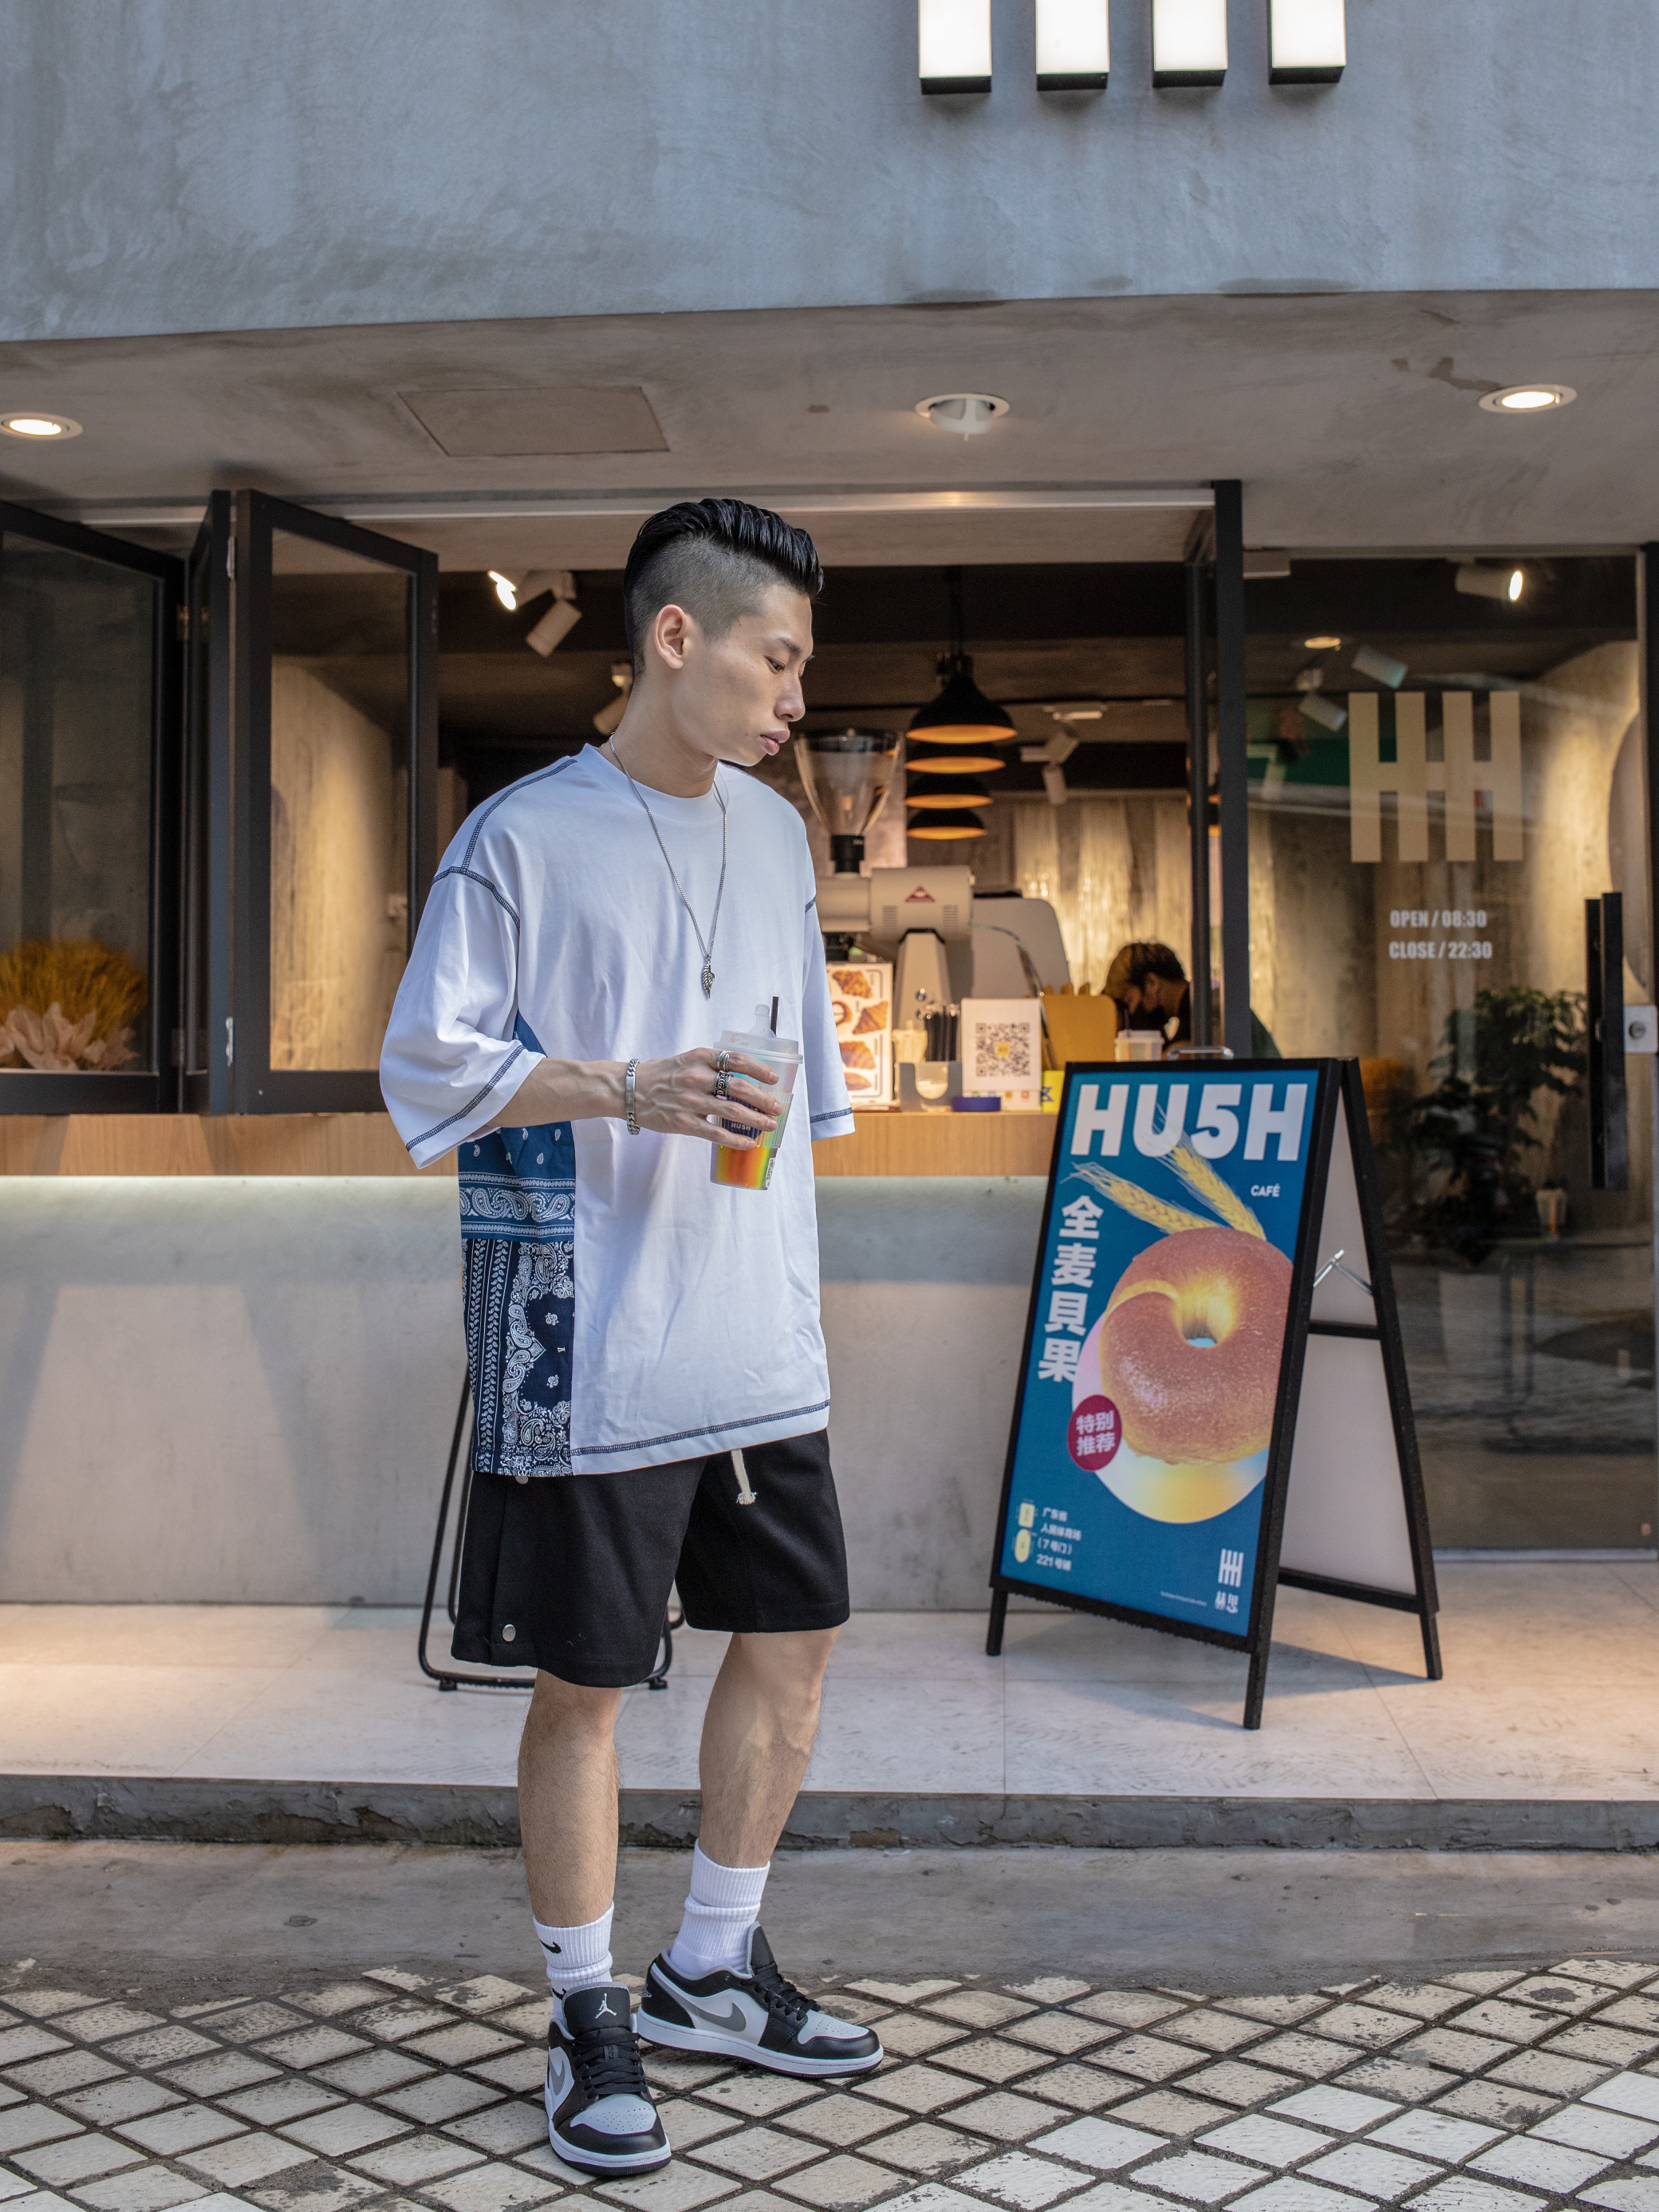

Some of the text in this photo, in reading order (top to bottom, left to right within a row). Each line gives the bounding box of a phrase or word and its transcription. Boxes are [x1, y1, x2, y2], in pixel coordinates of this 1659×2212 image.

[1389, 909, 1428, 927] OPEN
[1441, 909, 1488, 928] 08:30
[1389, 941, 1436, 959] CLOSE
[1448, 941, 1492, 959] 22:30
[1251, 1183, 1281, 1197] CAFÉ
[1076, 1410, 1114, 1435] 特别
[1076, 1432, 1116, 1457] 推荐
